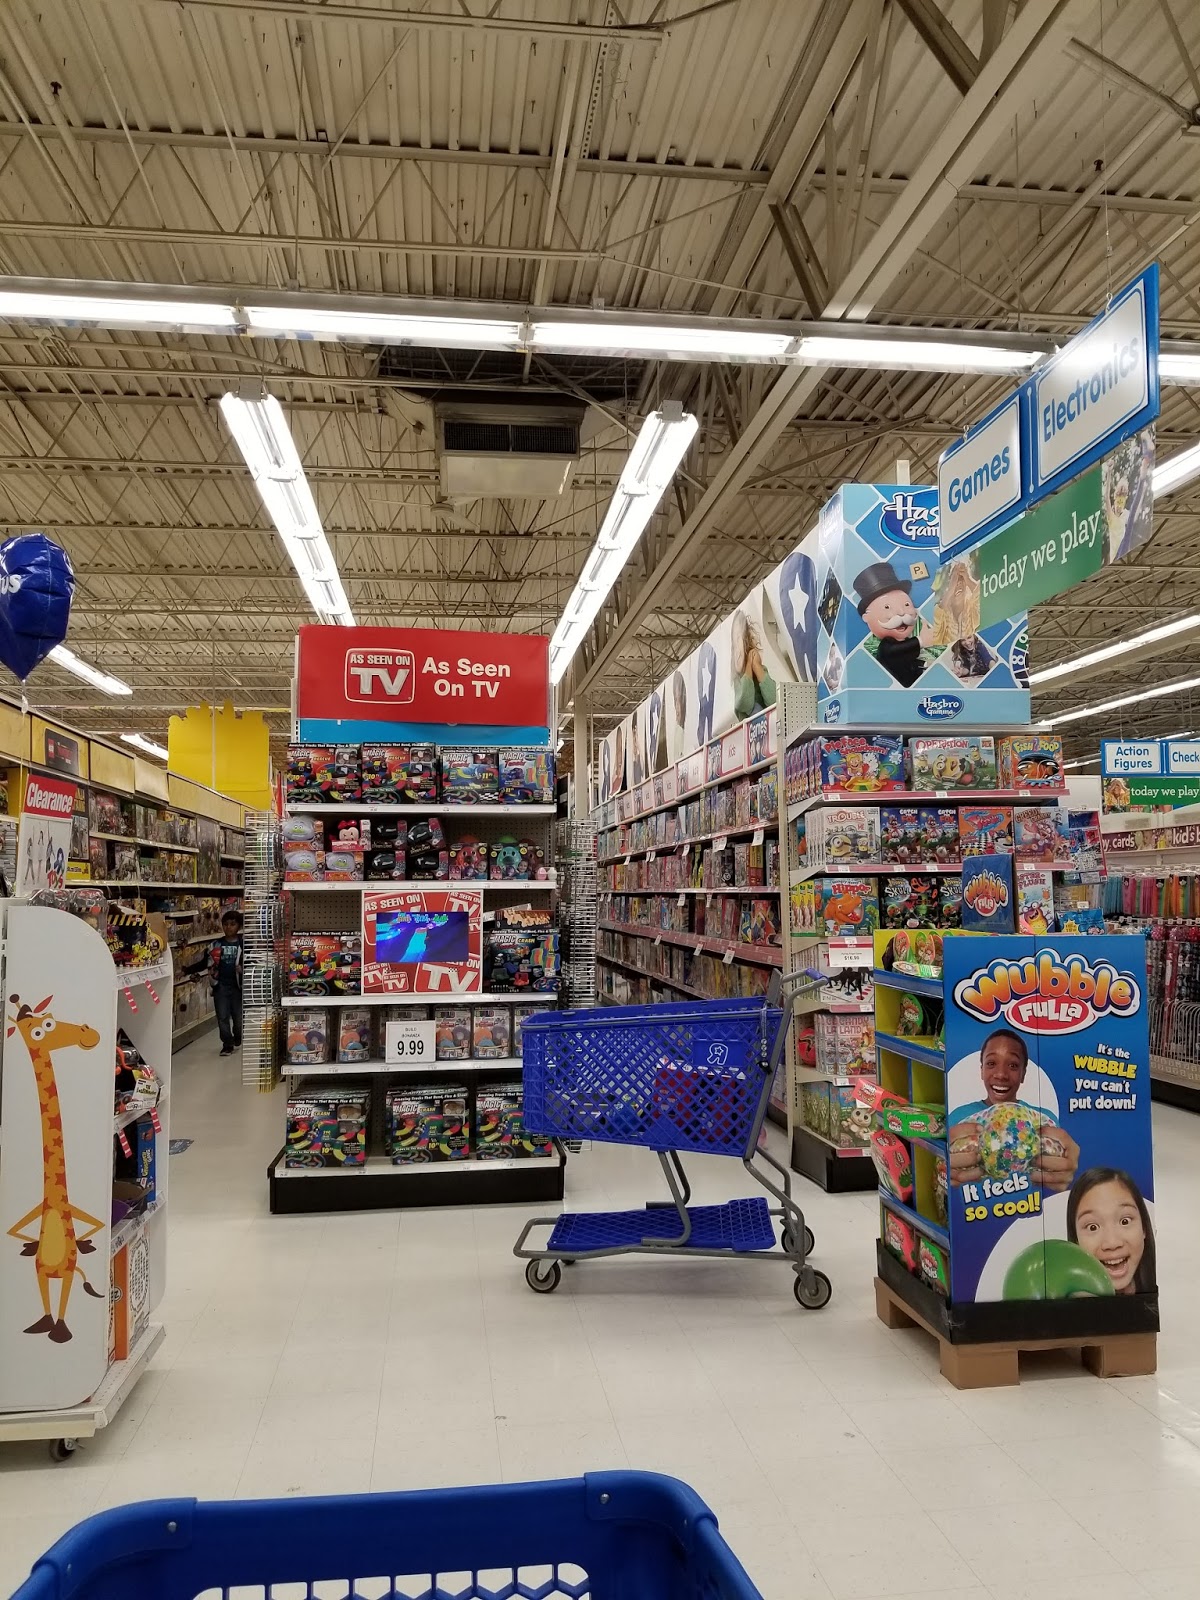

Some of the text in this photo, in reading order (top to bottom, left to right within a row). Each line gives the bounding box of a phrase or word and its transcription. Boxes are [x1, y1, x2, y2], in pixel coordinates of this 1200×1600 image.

[1044, 337, 1138, 442] Electronics
[948, 446, 1010, 512] Games
[982, 554, 1028, 598] today
[1030, 540, 1056, 571] we
[350, 654, 410, 666] AS SEEN ON
[422, 656, 511, 677] As Seen
[350, 667, 410, 696] TV
[434, 679, 500, 698] On TV
[920, 697, 959, 709] Hasbro
[1116, 746, 1150, 756] Action
[1172, 751, 1200, 762] Check
[1114, 759, 1152, 771] Figures
[26, 782, 73, 814] Clearance
[1131, 785, 1160, 798] today
[1161, 787, 1176, 796] we
[827, 810, 865, 823] TROUBLE
[1112, 834, 1135, 848] cards
[364, 894, 420, 911] AS SEEN ON
[459, 892, 473, 901] SEEN
[384, 978, 406, 990] TV
[422, 963, 478, 993] TV
[964, 956, 1132, 1012] Wubble
[840, 1017, 870, 1026] CANDY
[840, 1025, 862, 1035] LAND
[397, 1040, 424, 1055] 9.99
[1098, 1044, 1130, 1059] It's the
[1074, 1054, 1137, 1079] WUBBLE
[1075, 1077, 1130, 1094] you can't
[394, 1104, 418, 1112] MAGIC
[480, 1100, 502, 1109] MAGIC
[1070, 1094, 1136, 1112] put down!
[289, 1108, 312, 1116] MAGIC
[962, 1173, 1029, 1205] It feels
[965, 1191, 1040, 1222] so cool!
